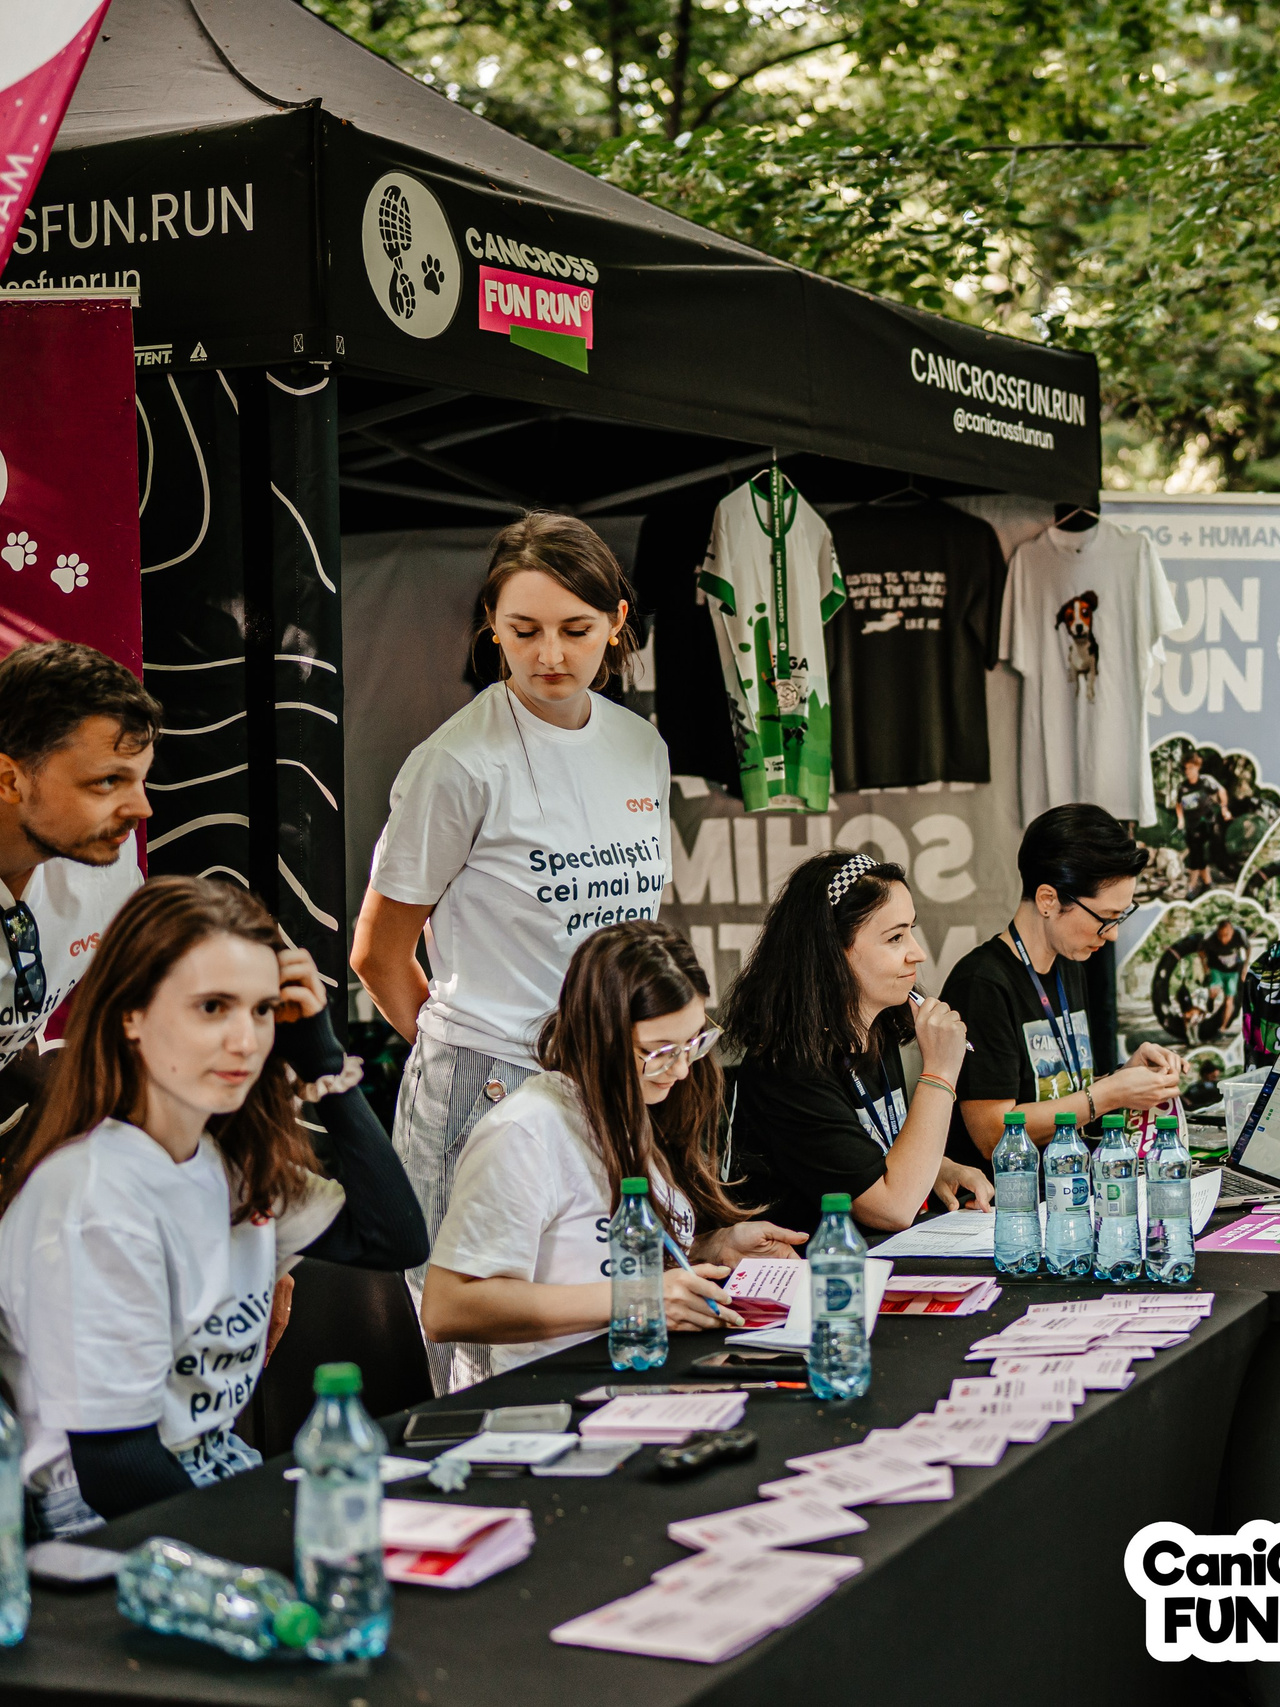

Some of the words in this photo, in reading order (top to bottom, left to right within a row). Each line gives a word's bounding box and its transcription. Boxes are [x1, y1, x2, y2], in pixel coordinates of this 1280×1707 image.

[464, 226, 600, 284] CANICROSS
[484, 279, 532, 319] FUN
[910, 347, 1086, 427] CANICROSSFUN.RUN
[953, 407, 1055, 450] @canicrossfunrun
[536, 876, 579, 904] cei
[587, 871, 630, 900] mai
